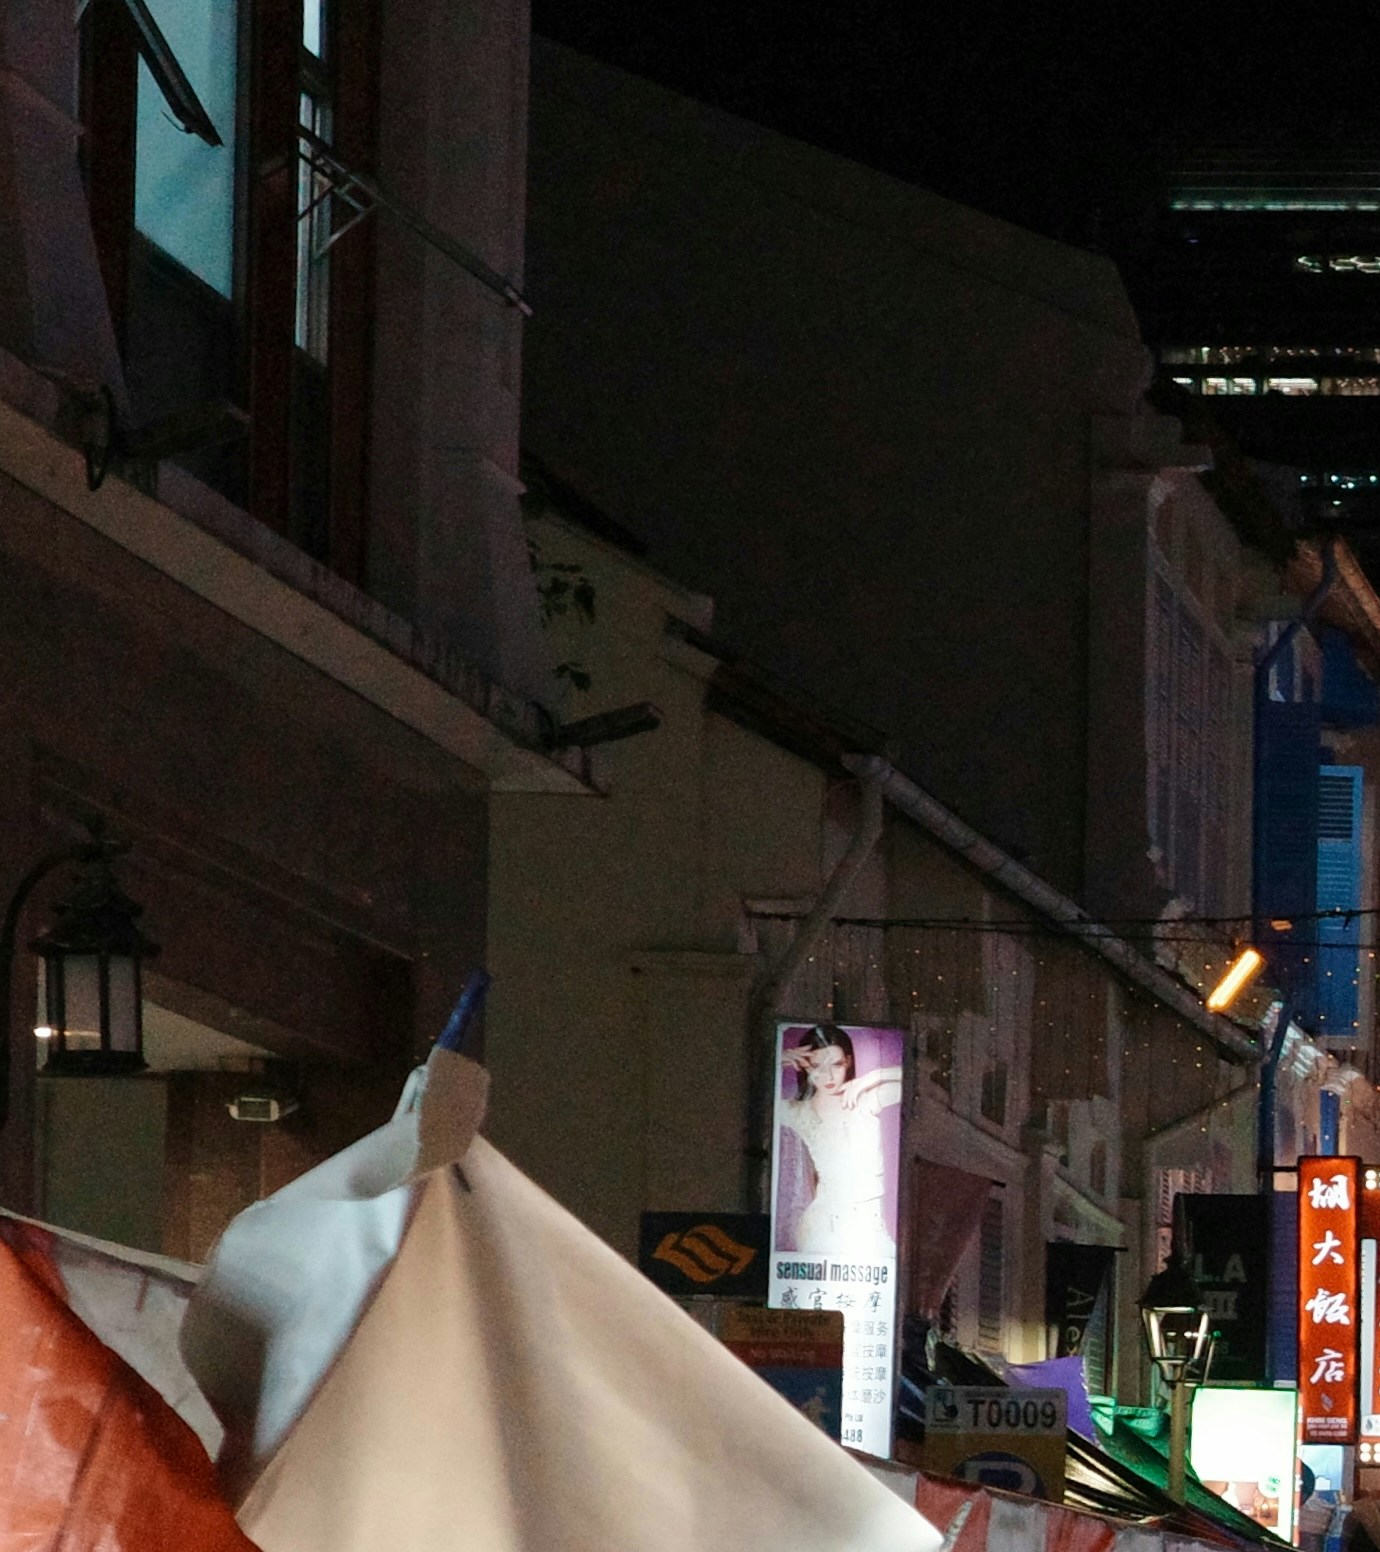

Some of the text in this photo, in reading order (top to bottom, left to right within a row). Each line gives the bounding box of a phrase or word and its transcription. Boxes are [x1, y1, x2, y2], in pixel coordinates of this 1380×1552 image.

[776, 1259, 889, 1286] sensual massage
[780, 1286, 883, 1313] 感官按摩
[967, 1398, 1057, 1428] T0009
